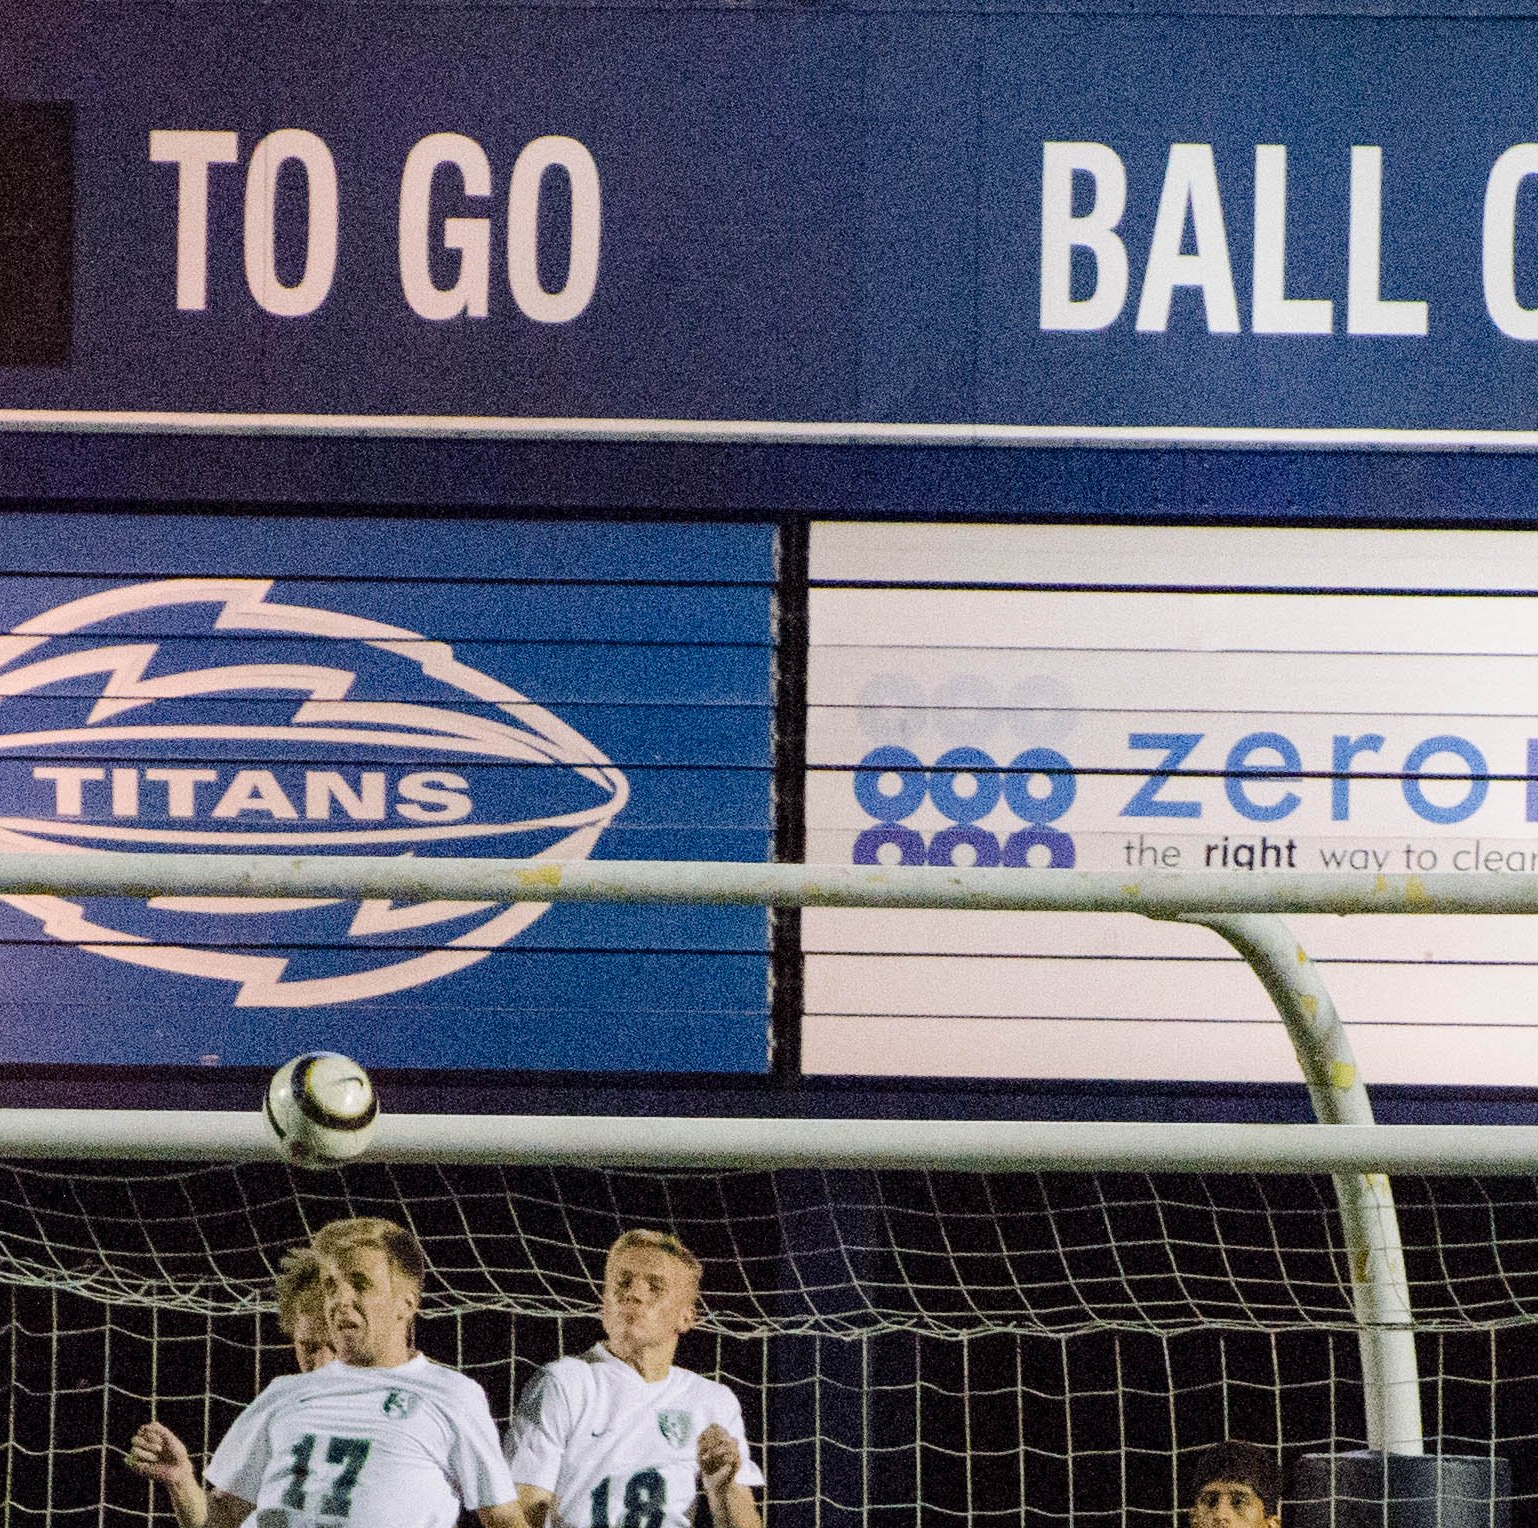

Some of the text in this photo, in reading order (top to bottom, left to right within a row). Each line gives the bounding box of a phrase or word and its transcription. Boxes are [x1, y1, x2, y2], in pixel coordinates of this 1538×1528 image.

[150, 129, 602, 323] TO GO
[1039, 141, 1429, 337] BALL
[32, 766, 473, 824] TITANS
[1123, 835, 1181, 868] the
[1204, 836, 1297, 871] right
[1319, 848, 1389, 872] way
[1404, 843, 1439, 871] to
[281, 1433, 372, 1518] 17
